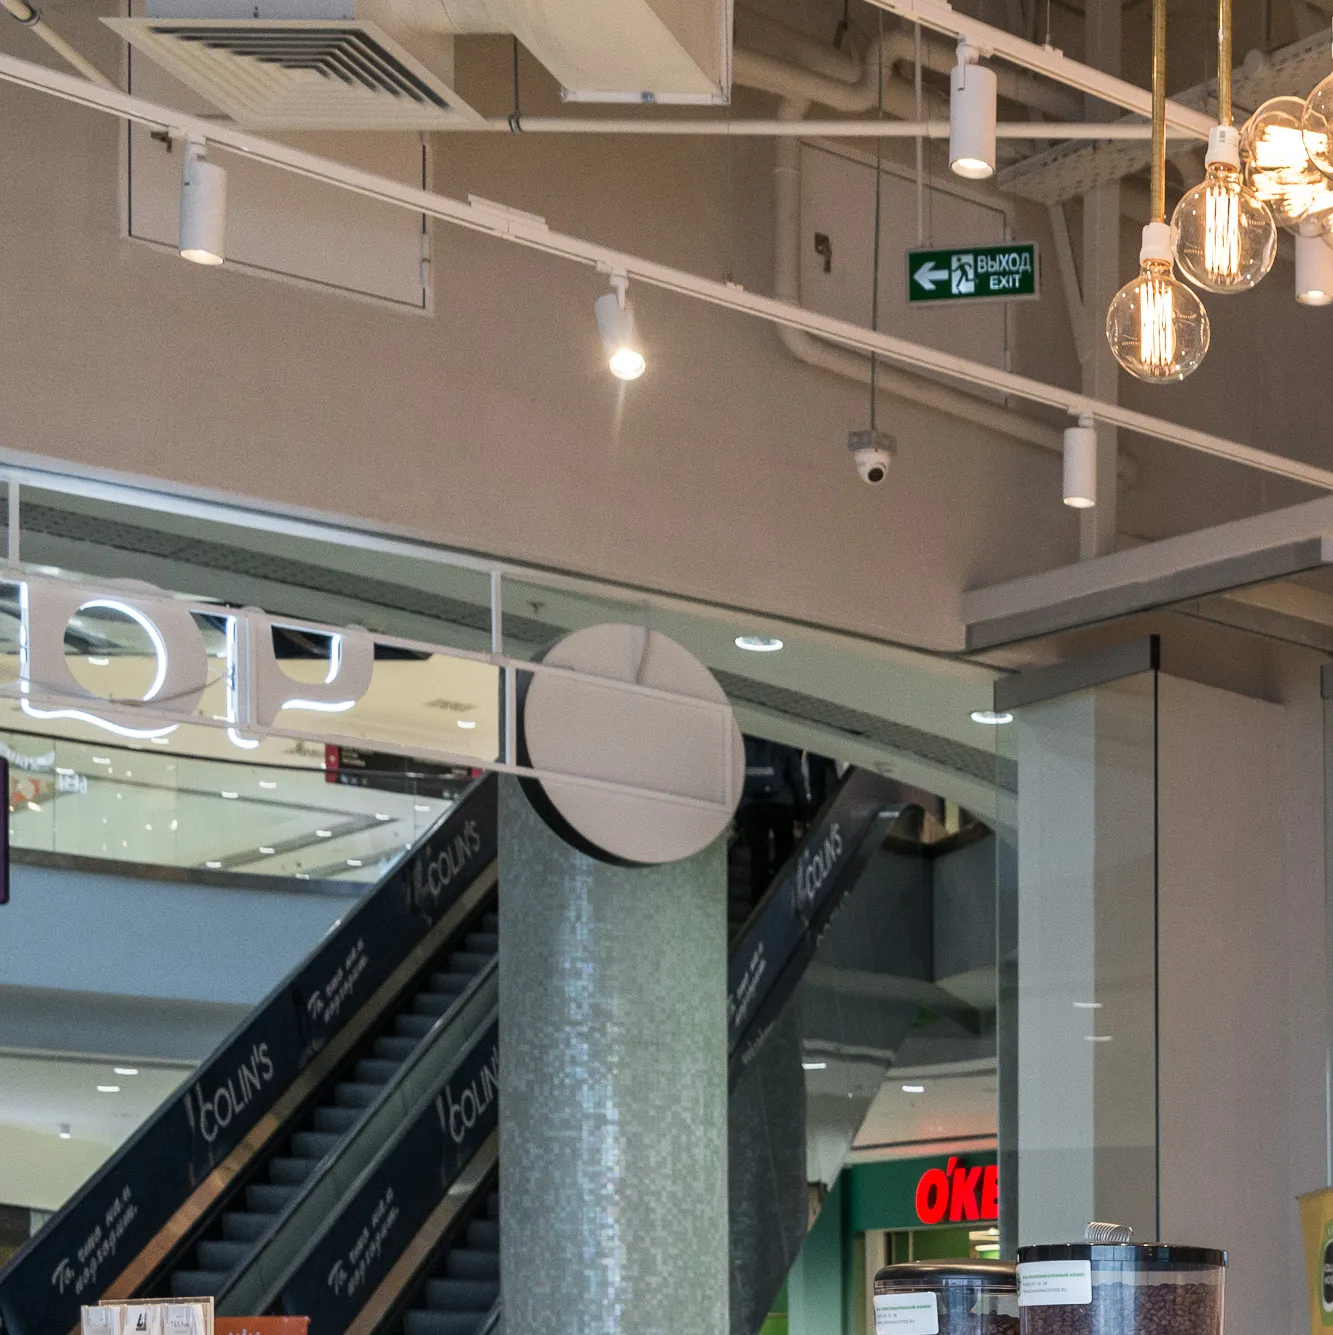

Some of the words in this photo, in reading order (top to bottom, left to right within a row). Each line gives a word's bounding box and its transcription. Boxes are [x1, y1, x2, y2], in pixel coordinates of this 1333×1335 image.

[977, 253, 1031, 274] ВЫХОД
[990, 274, 1021, 290] EXIT
[428, 820, 480, 896] COLIN'S
[200, 1042, 274, 1143] COLIN'S
[915, 1156, 999, 1224] О'КЕ
